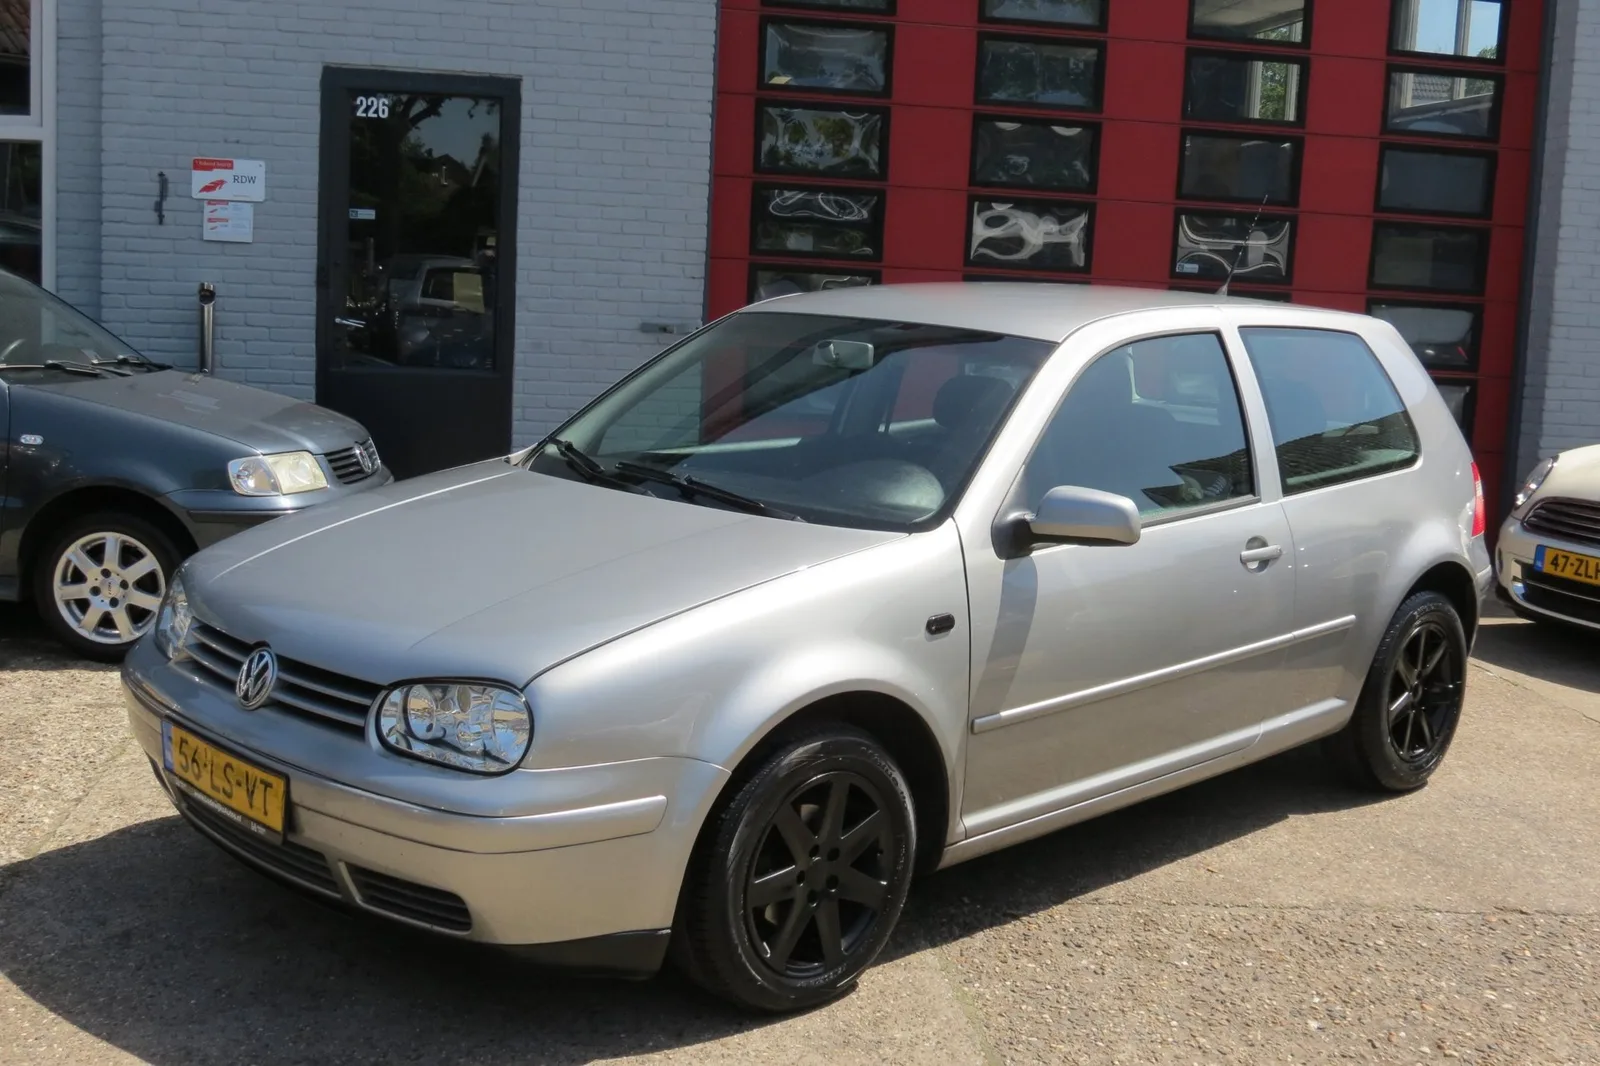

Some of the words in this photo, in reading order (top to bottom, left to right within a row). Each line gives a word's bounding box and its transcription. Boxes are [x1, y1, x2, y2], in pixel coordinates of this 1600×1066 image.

[356, 96, 389, 119] 226
[233, 175, 257, 184] RDW
[178, 736, 273, 817] 56-LS-VT
